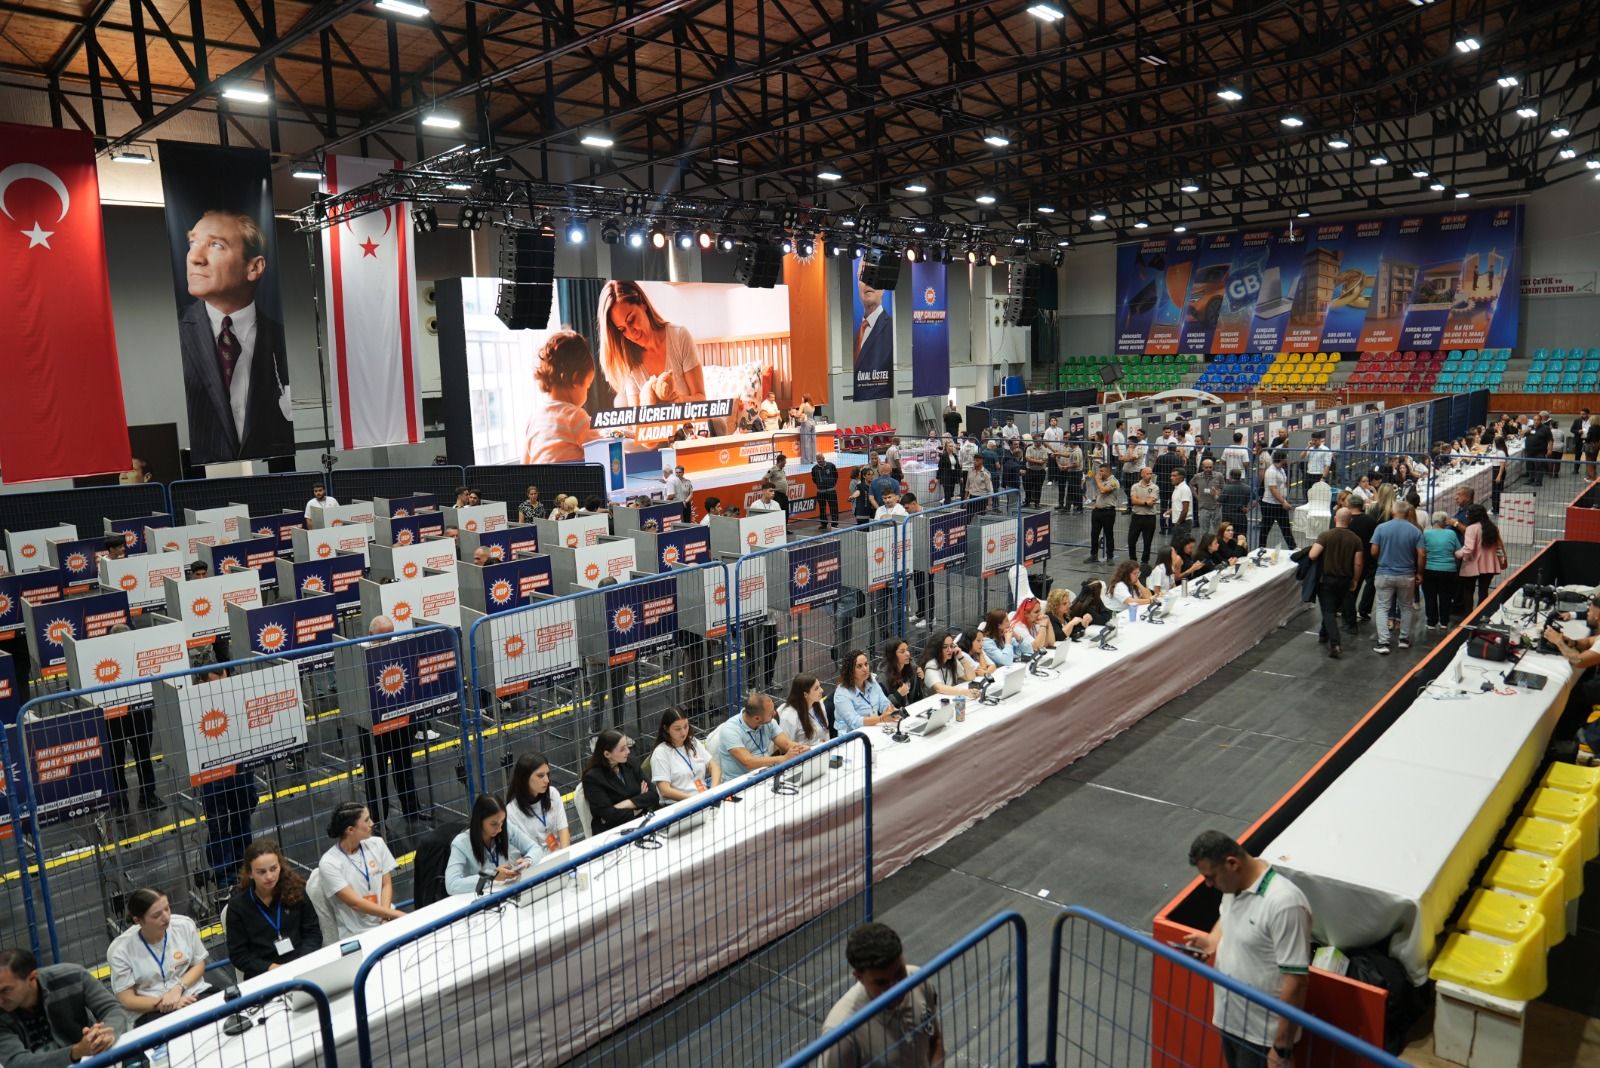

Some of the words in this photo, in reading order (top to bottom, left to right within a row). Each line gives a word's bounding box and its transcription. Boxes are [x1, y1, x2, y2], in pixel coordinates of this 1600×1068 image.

[1230, 275, 1260, 298] GB
[857, 370, 871, 381] ÜNAL
[872, 369, 889, 380] ÜSTEL
[594, 407, 637, 427] ASGARİ
[638, 404, 681, 422] ÜCRETİN
[684, 401, 708, 420] ÜÇTE
[710, 400, 731, 416] BİRİ
[638, 424, 673, 440] KADAR
[792, 499, 815, 512] HAZIR
[195, 603, 209, 612] UBP
[265, 633, 280, 643] UBP
[100, 665, 117, 677] UBP
[40, 758, 61, 770] ADAY
[63, 749, 101, 763] SIRALAMA
